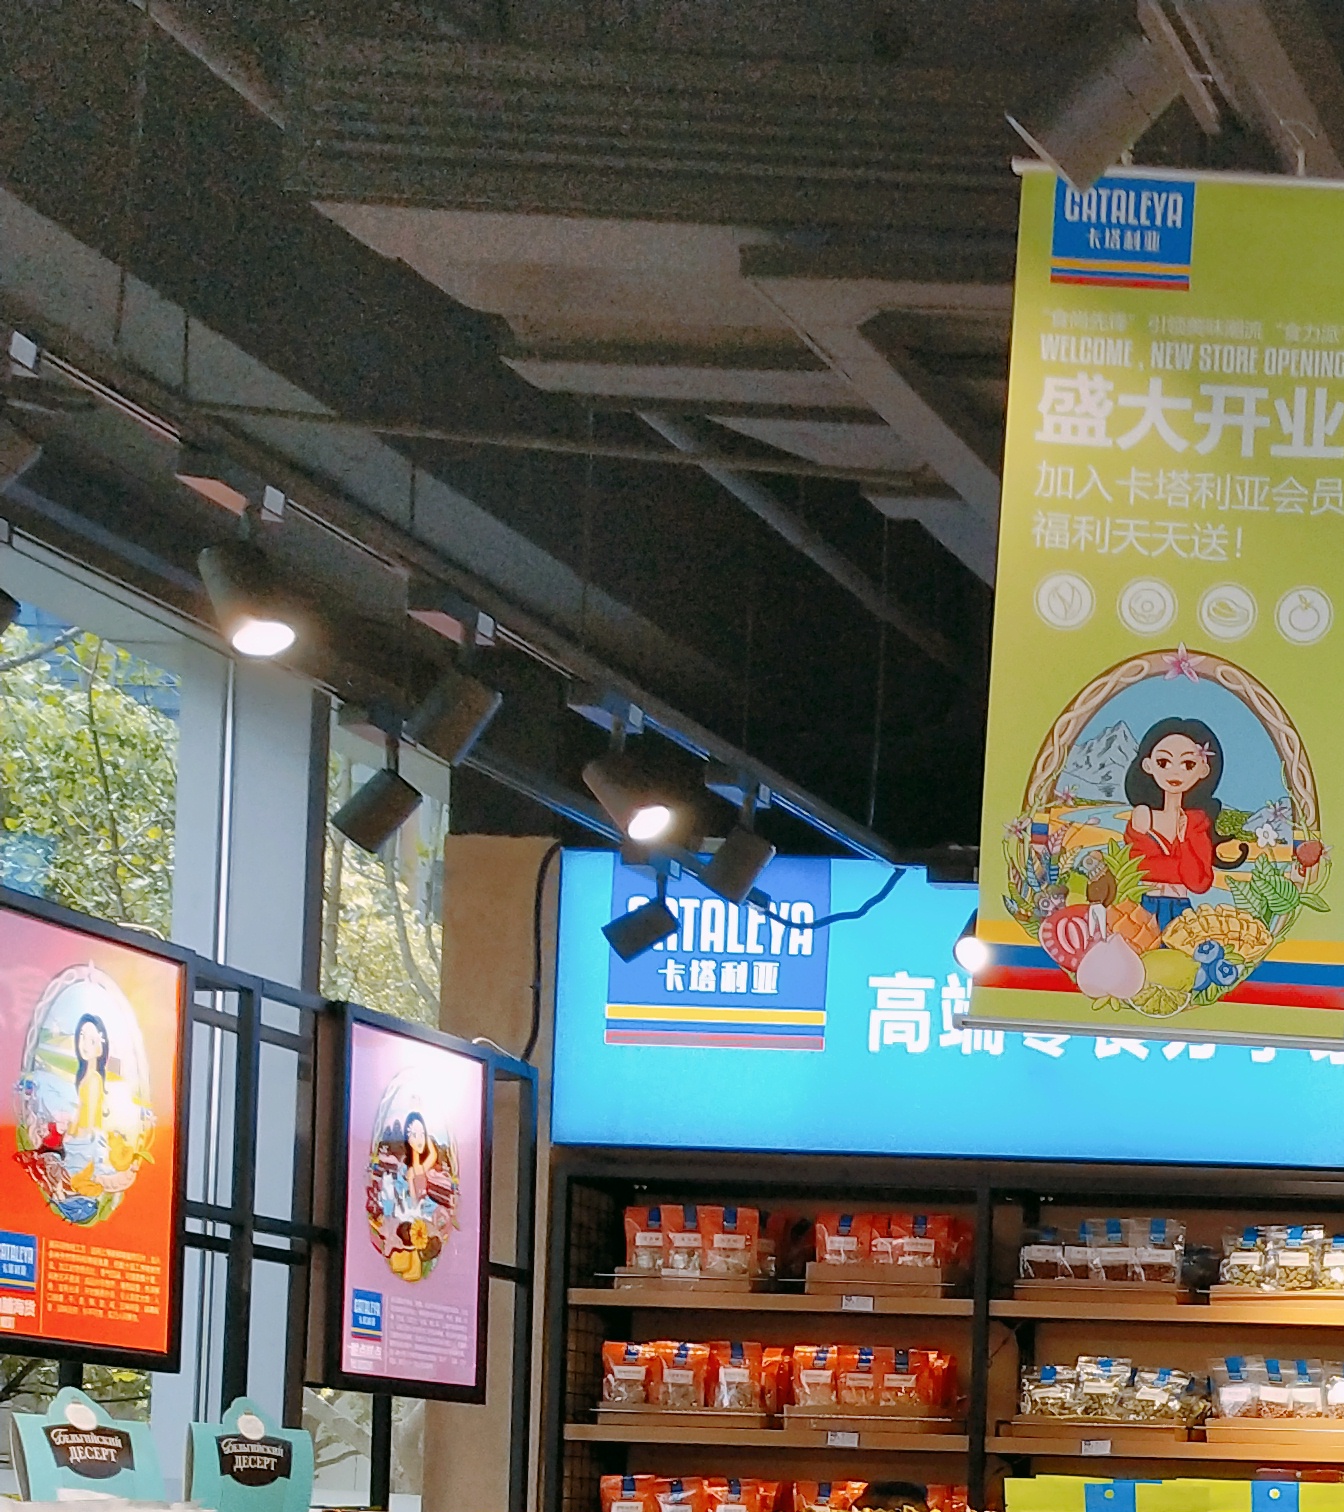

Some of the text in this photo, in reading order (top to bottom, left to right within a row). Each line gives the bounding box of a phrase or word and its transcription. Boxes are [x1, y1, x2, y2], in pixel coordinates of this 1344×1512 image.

[1064, 186, 1184, 229] CATALEYA
[1150, 340, 1194, 371] NEW
[1199, 343, 1258, 376] STORE
[657, 958, 780, 995] 卡塔利亚
[68, 1446, 119, 1465] ДЕСЕРТ
[233, 1454, 278, 1473] ДЕСЕРТ
